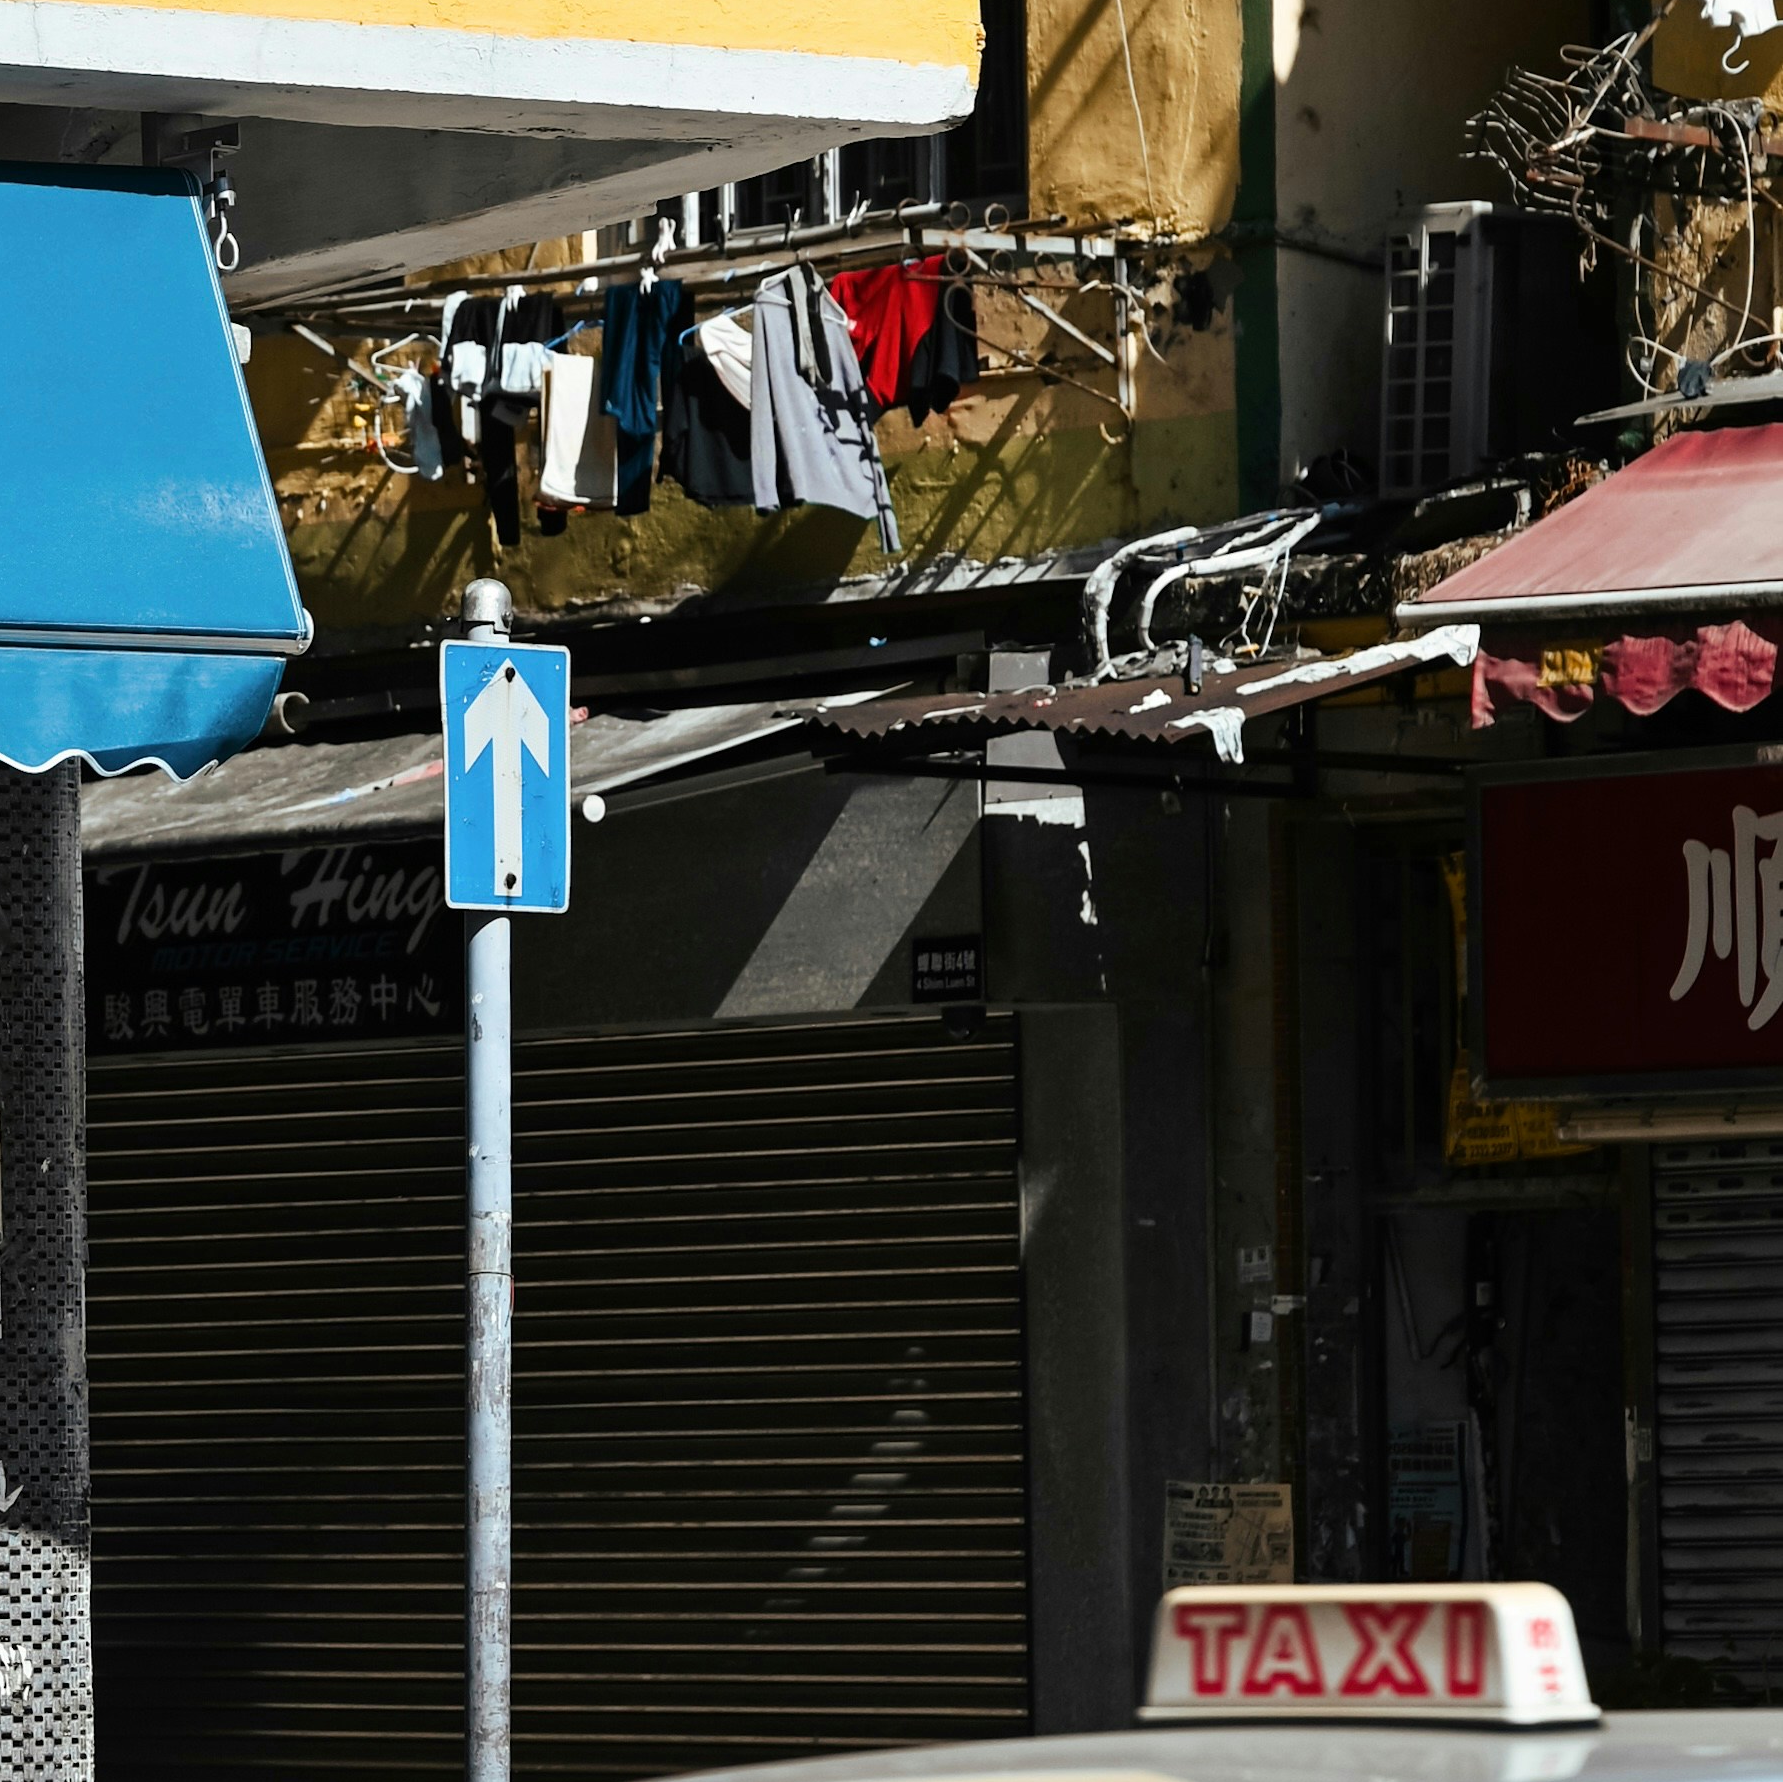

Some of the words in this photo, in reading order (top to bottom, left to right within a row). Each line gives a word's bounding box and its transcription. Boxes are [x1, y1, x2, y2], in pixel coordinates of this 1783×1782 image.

[95, 864, 248, 945] Tsun
[280, 845, 446, 955] Hing
[152, 939, 256, 972] MOTOR
[261, 929, 396, 965] SERVICE
[103, 972, 442, 1040] 駿興電單車服務中心
[1174, 1602, 1487, 1697] TAXI
